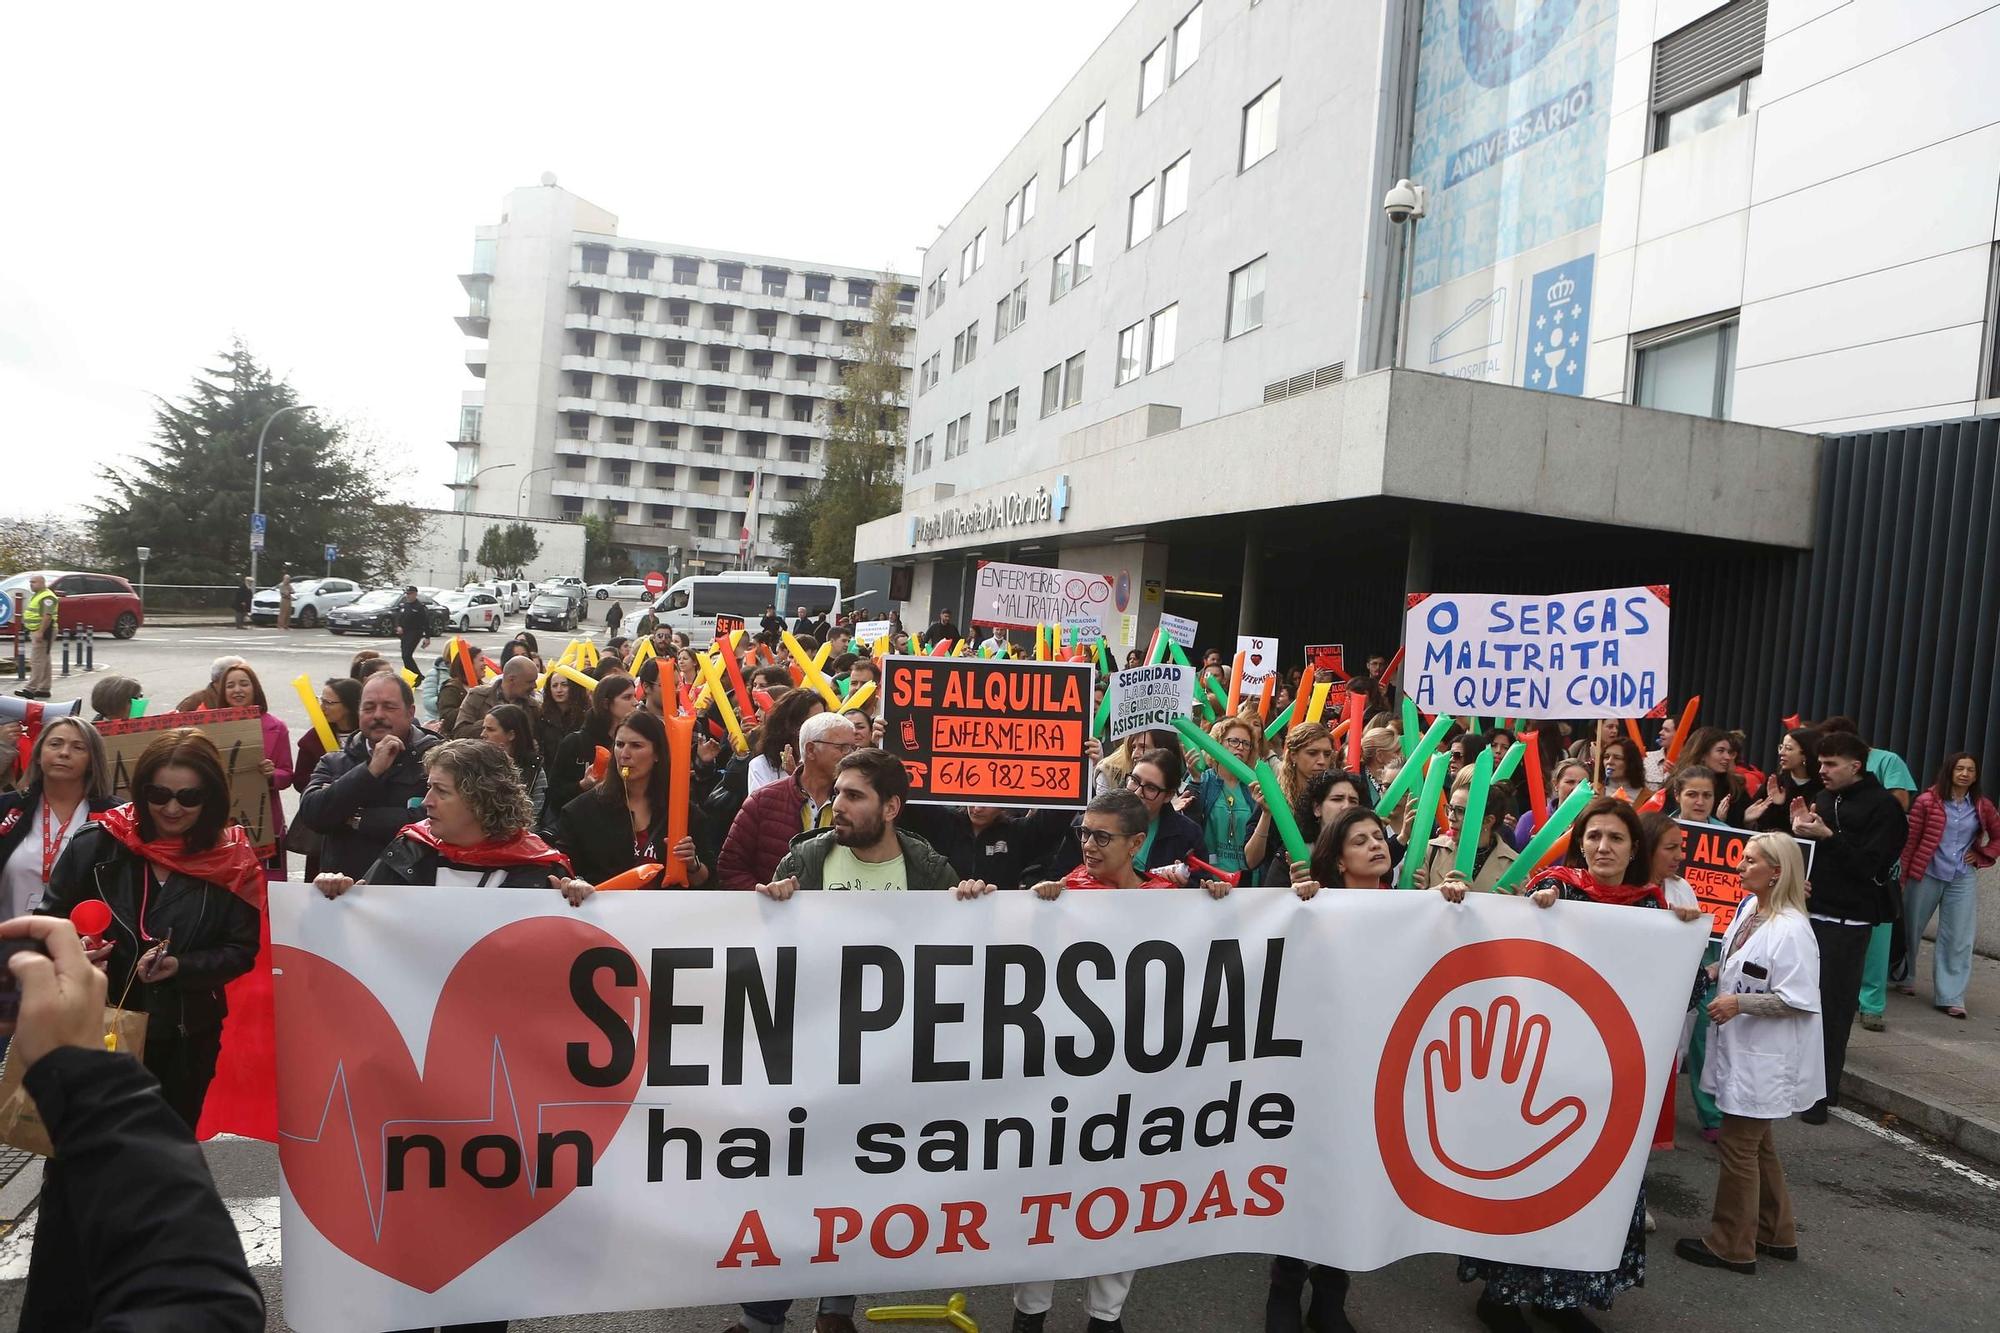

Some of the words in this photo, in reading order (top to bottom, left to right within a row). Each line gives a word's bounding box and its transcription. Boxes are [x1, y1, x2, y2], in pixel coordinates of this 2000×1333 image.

[1450, 89, 1588, 181] ANIVERSARIO
[1006, 486, 1048, 526] Coruña
[981, 567, 1061, 595] ENFERMEIRAS
[996, 594, 1090, 622] MALTRATADAS
[1426, 601, 1459, 635] O
[1488, 597, 1649, 635] SERGAS
[717, 619, 729, 632] SE
[1251, 639, 1264, 650] YO
[1423, 639, 1619, 675] MALTRATA
[892, 668, 933, 707] SE
[942, 670, 1082, 713] ALQUILA
[1119, 667, 1182, 688] SEGURIDAD
[1124, 683, 1180, 702] LABORAL
[1415, 675, 1435, 706] A
[1453, 676, 1550, 709] QUEN
[1566, 671, 1656, 709] COIDA
[1113, 709, 1185, 737] ASISTENCIA
[1118, 696, 1179, 717] SEGURIDAD
[935, 718, 1065, 752] ENFERMEIRA
[940, 761, 981, 789] 616
[988, 761, 1025, 790] 982
[1031, 766, 1071, 791] 588
[1693, 832, 1744, 868] ALQ
[1687, 868, 1742, 889] ENFERM
[566, 945, 797, 1088] SEN
[837, 937, 1304, 1085] PERSOAL
[386, 1129, 594, 1192] non
[647, 1106, 808, 1182] hai
[854, 1080, 1296, 1175] sanidade
[716, 1209, 780, 1268] A
[810, 1200, 990, 1264] POR
[1020, 1164, 1288, 1246] TODAS
